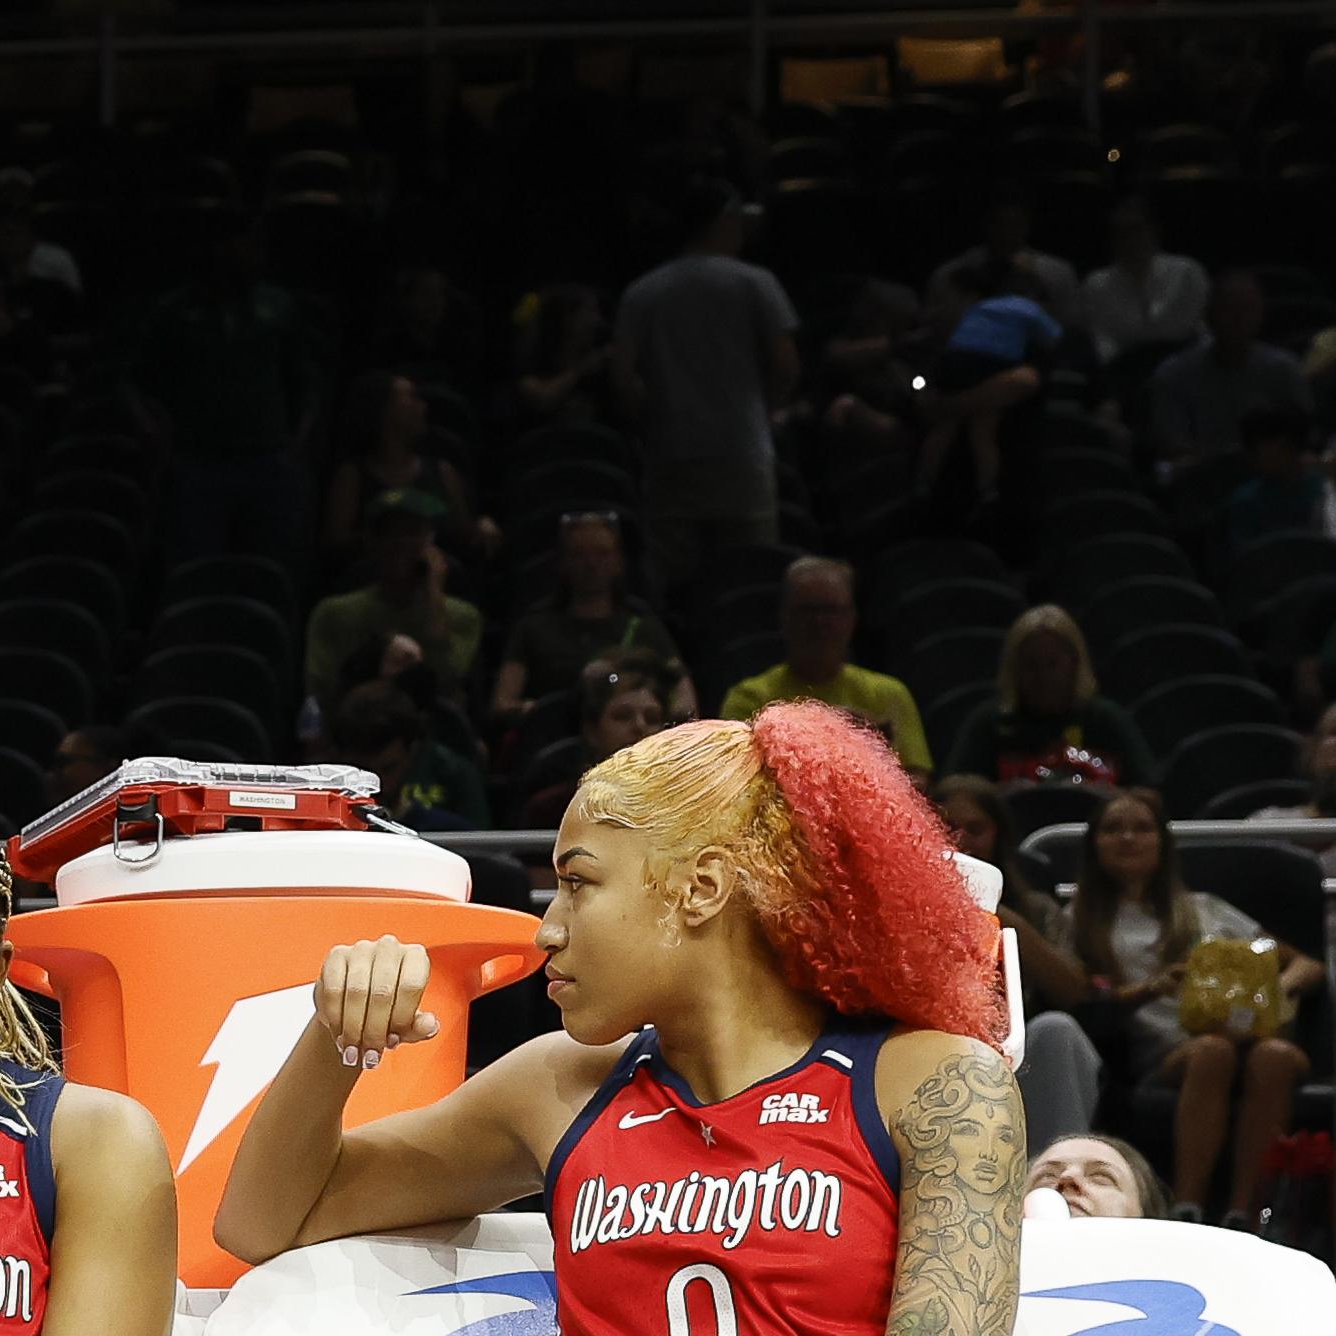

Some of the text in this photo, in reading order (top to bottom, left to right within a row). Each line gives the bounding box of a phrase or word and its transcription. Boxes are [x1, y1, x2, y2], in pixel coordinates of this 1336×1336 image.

[762, 1092, 820, 1110] CAR
[758, 1107, 829, 1125] max
[570, 1160, 841, 1254] Washington
